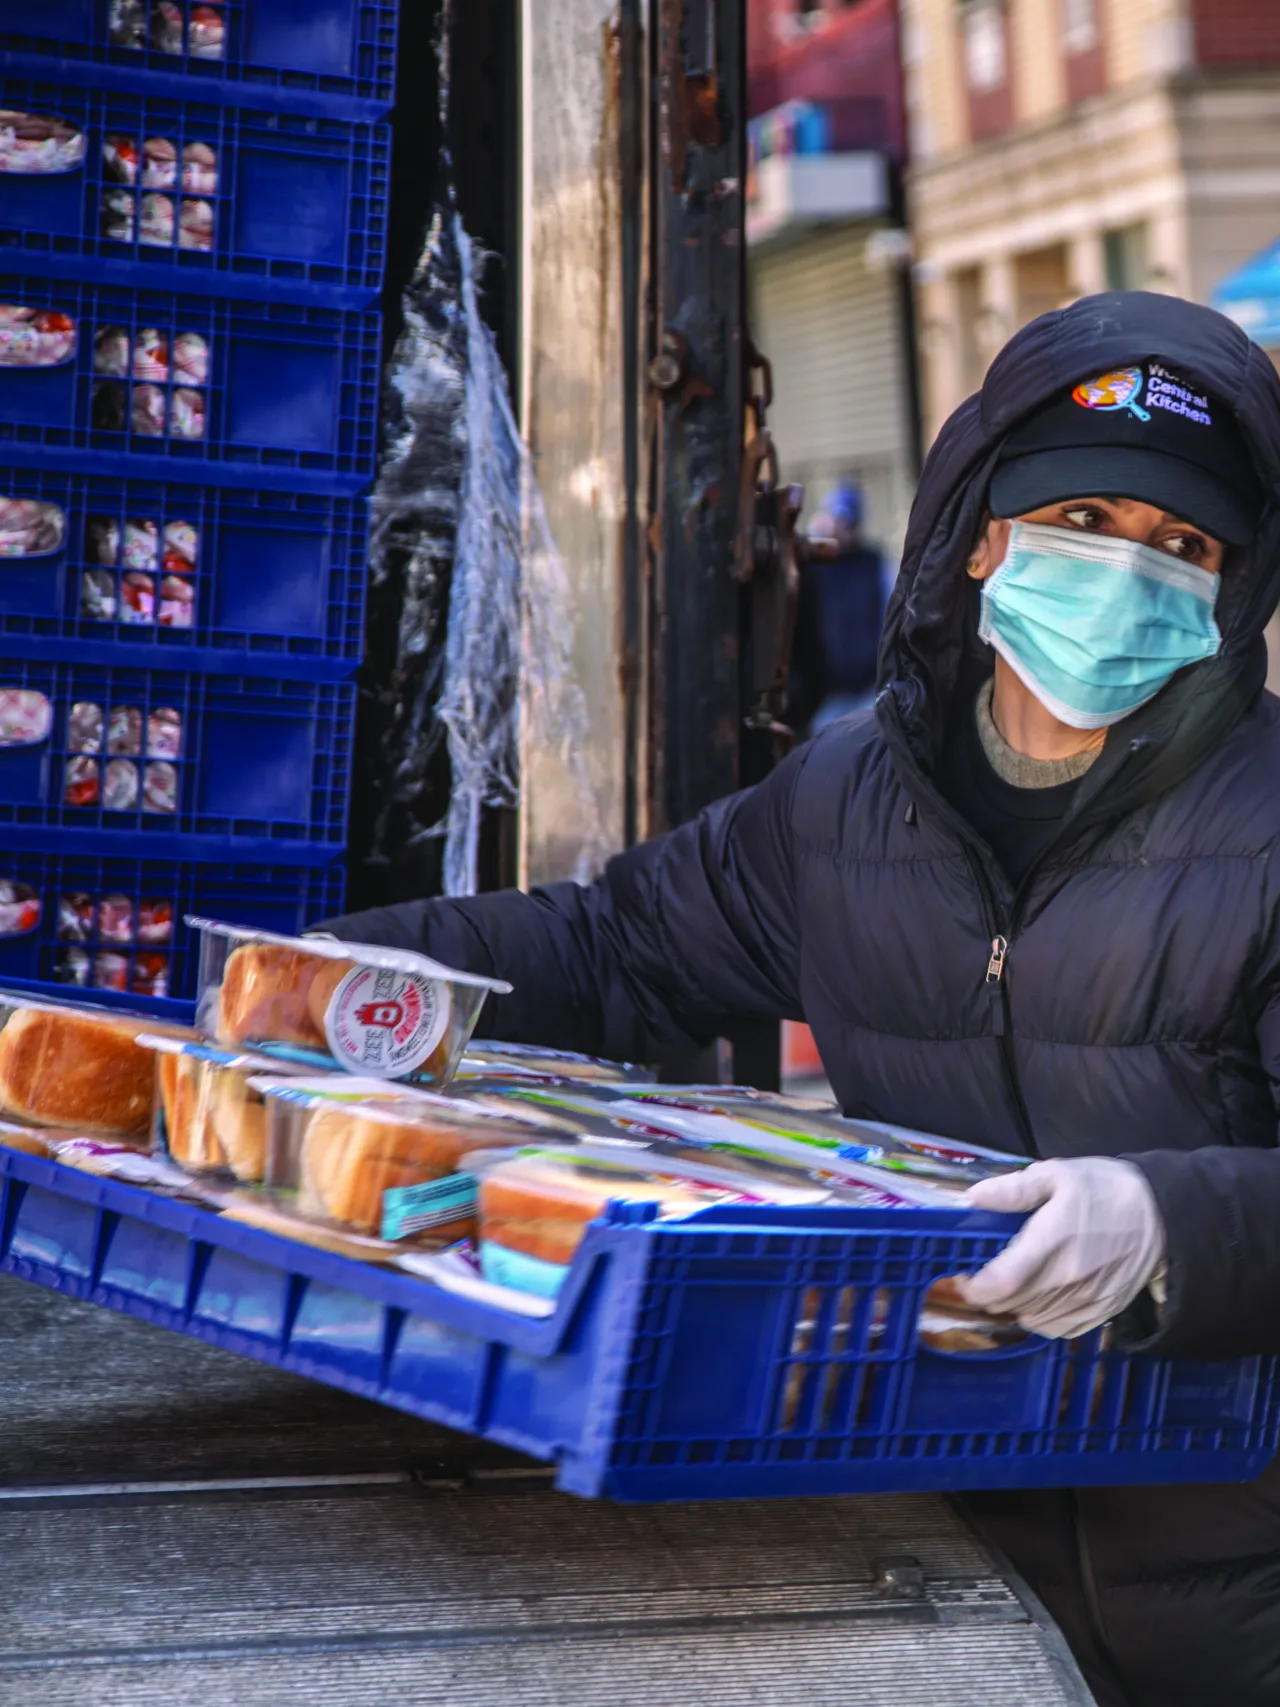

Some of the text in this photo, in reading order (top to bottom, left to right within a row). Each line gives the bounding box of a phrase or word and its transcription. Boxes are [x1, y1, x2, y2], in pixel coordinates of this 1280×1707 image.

[1145, 391, 1211, 425] Kitchen
[1148, 377, 1208, 408] Central
[362, 1027, 384, 1062] ZEE
